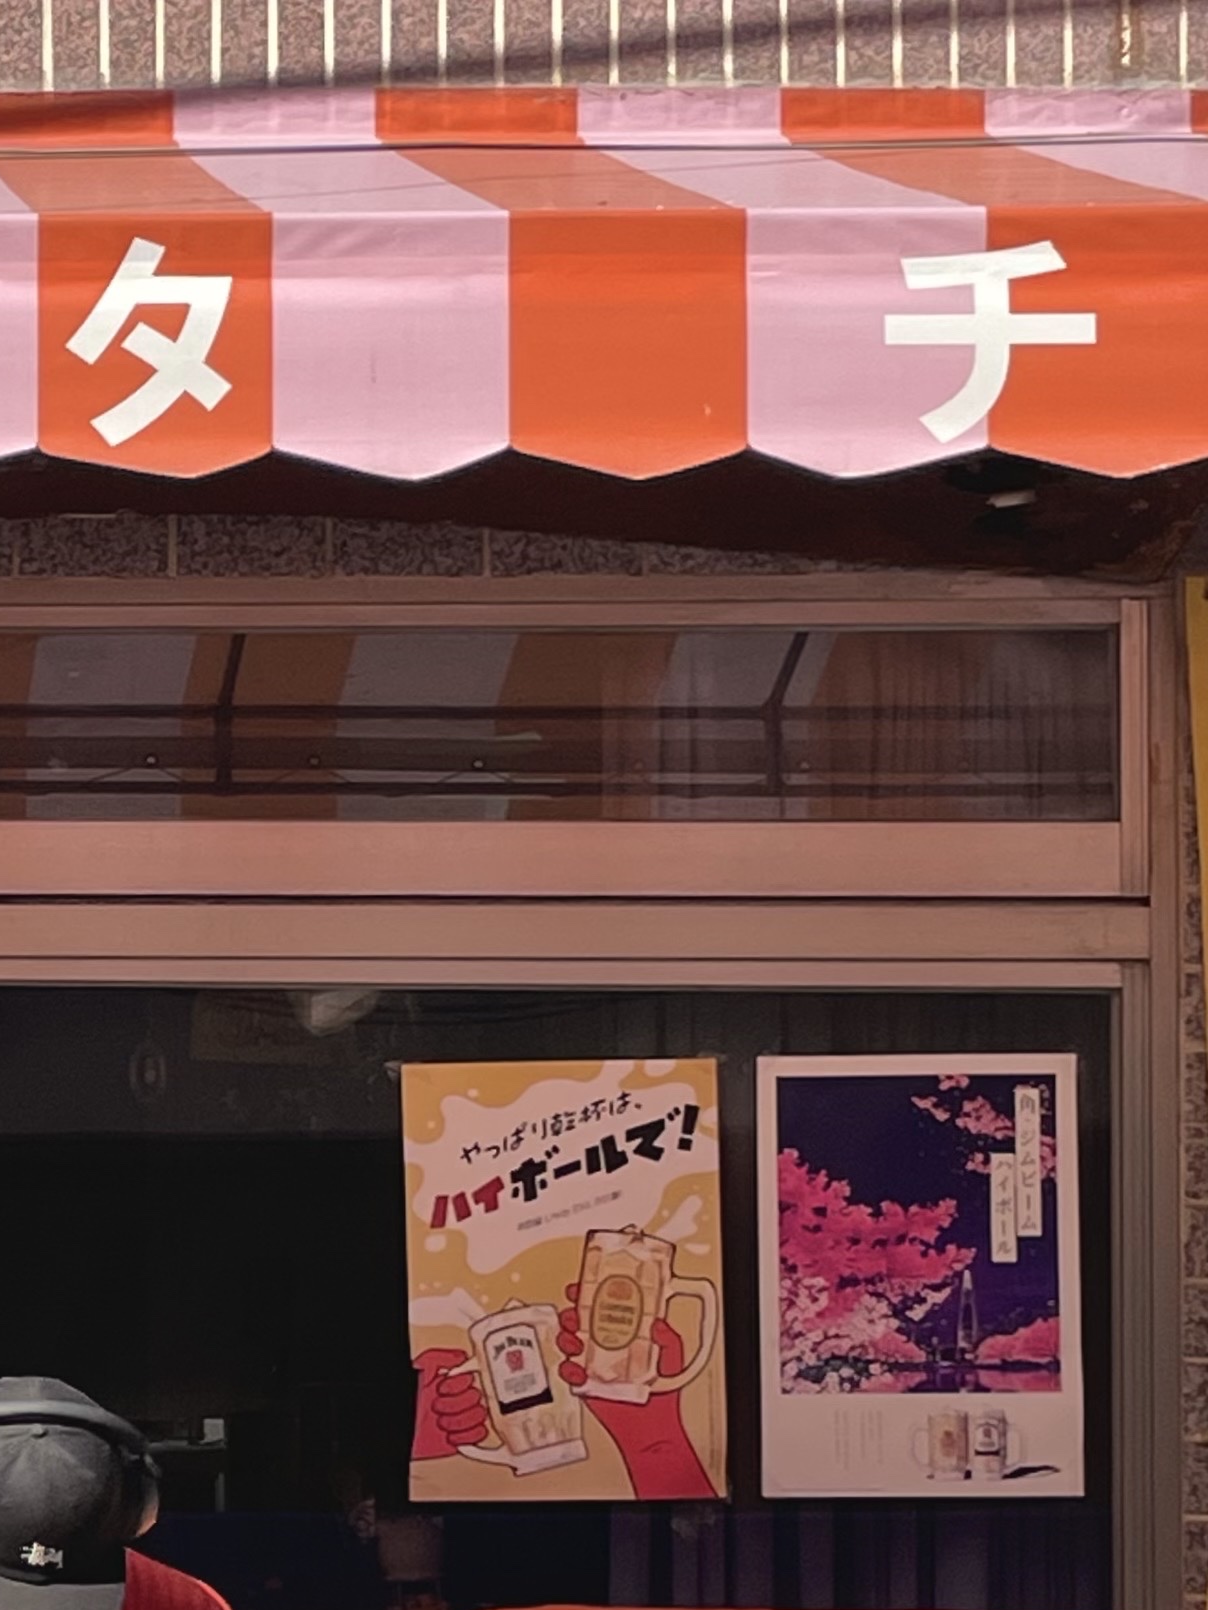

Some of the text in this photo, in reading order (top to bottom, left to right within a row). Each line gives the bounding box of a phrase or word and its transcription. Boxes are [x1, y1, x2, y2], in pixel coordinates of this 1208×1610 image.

[995, 1160, 1012, 1254] ハイボール
